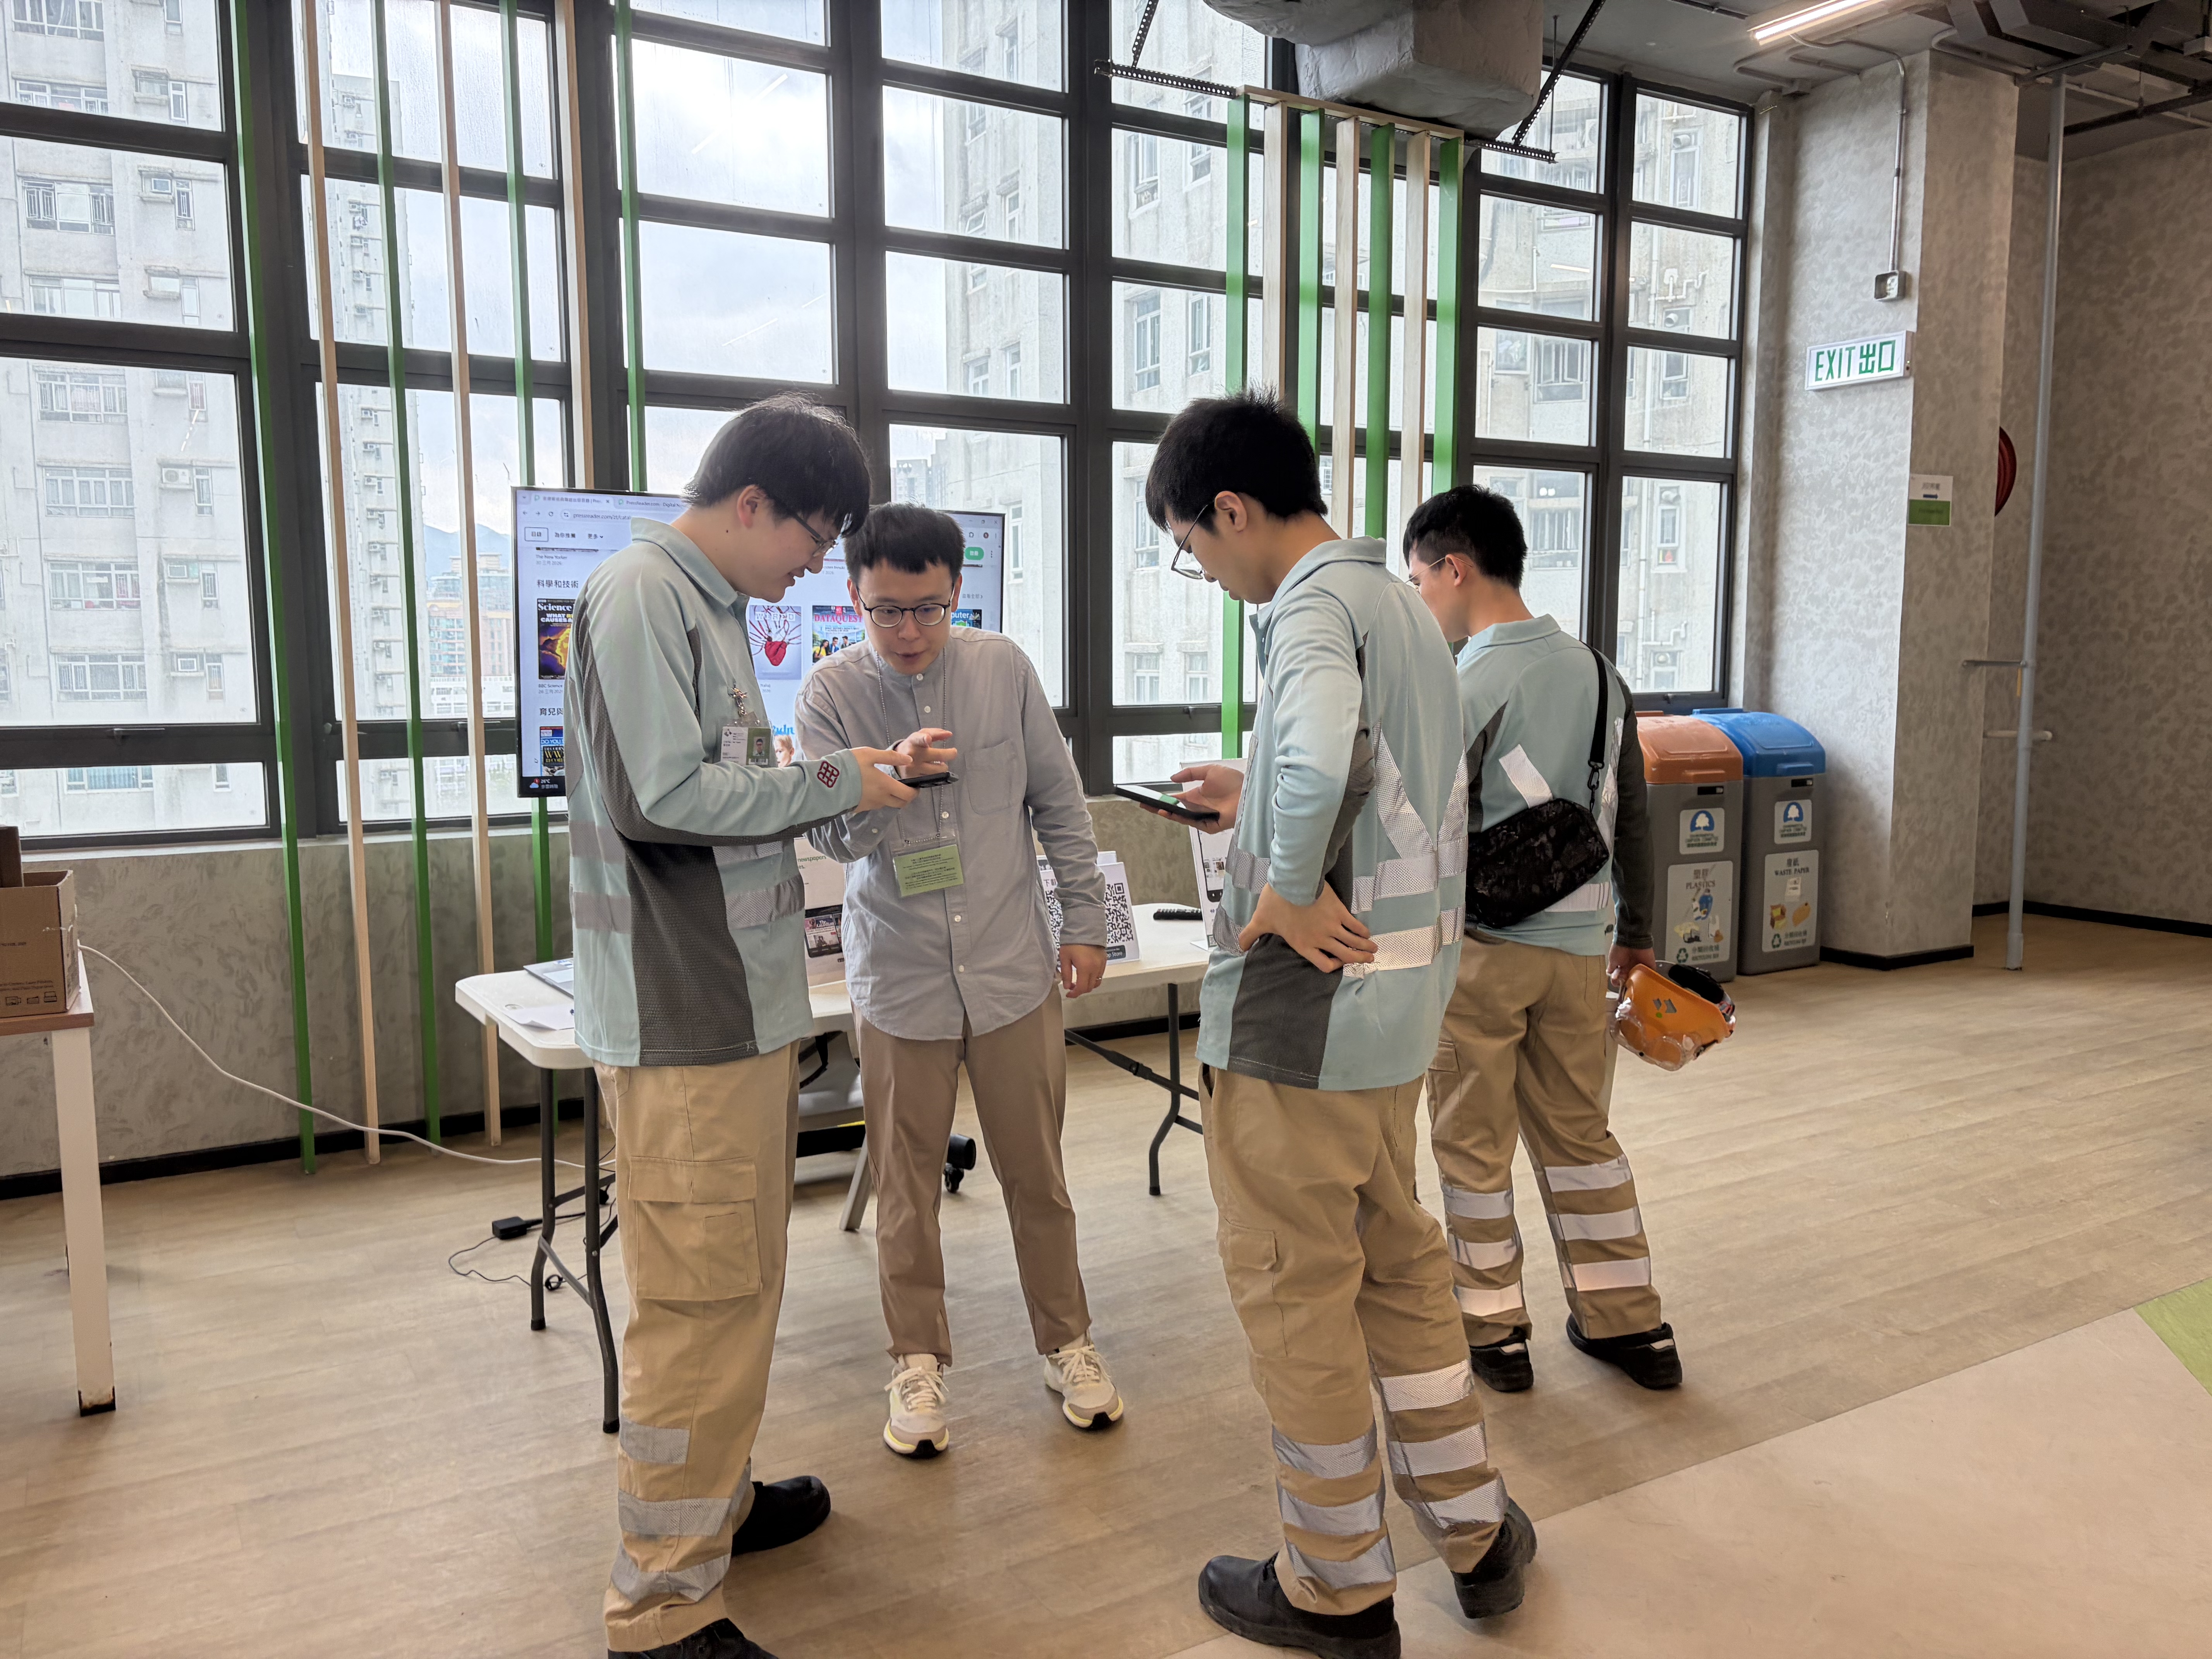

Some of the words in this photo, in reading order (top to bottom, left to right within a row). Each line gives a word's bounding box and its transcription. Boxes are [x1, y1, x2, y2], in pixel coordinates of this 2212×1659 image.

[1815, 346, 1856, 382] EXIT
[1859, 340, 1896, 374] 出口
[537, 579, 579, 588] 科學和技術
[538, 603, 572, 611] Science
[814, 614, 862, 624] DATAQUEST
[1686, 880, 1716, 890] PLASTICS
